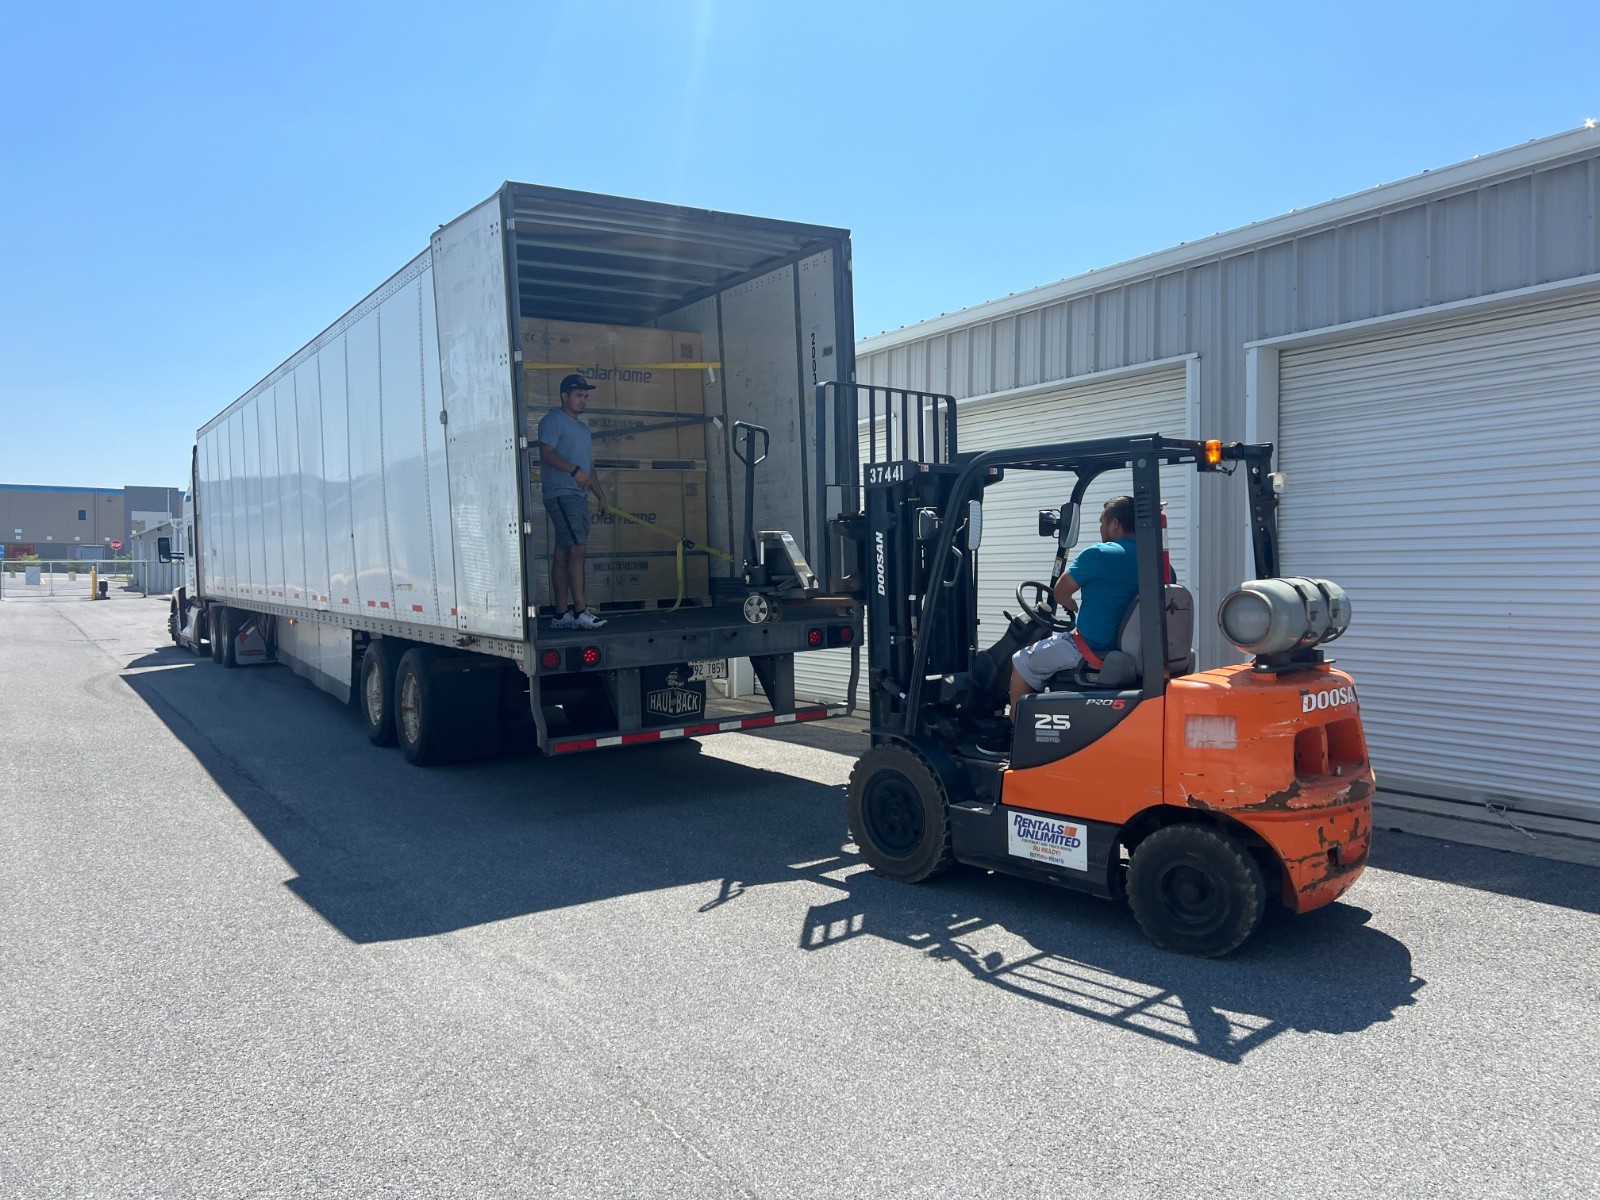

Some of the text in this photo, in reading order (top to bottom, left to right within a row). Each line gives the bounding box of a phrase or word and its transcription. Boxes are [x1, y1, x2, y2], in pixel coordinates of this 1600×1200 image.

[869, 465, 904, 484] 37441
[875, 531, 886, 596] DOOSAN
[707, 662, 721, 675] 785
[675, 692, 699, 713] BACK
[1085, 699, 1127, 710] PRO5
[1302, 686, 1356, 713] DOOSA
[1034, 713, 1071, 730] 25
[1013, 814, 1065, 835] RENTALS
[1017, 825, 1081, 848] UNLIMITED
